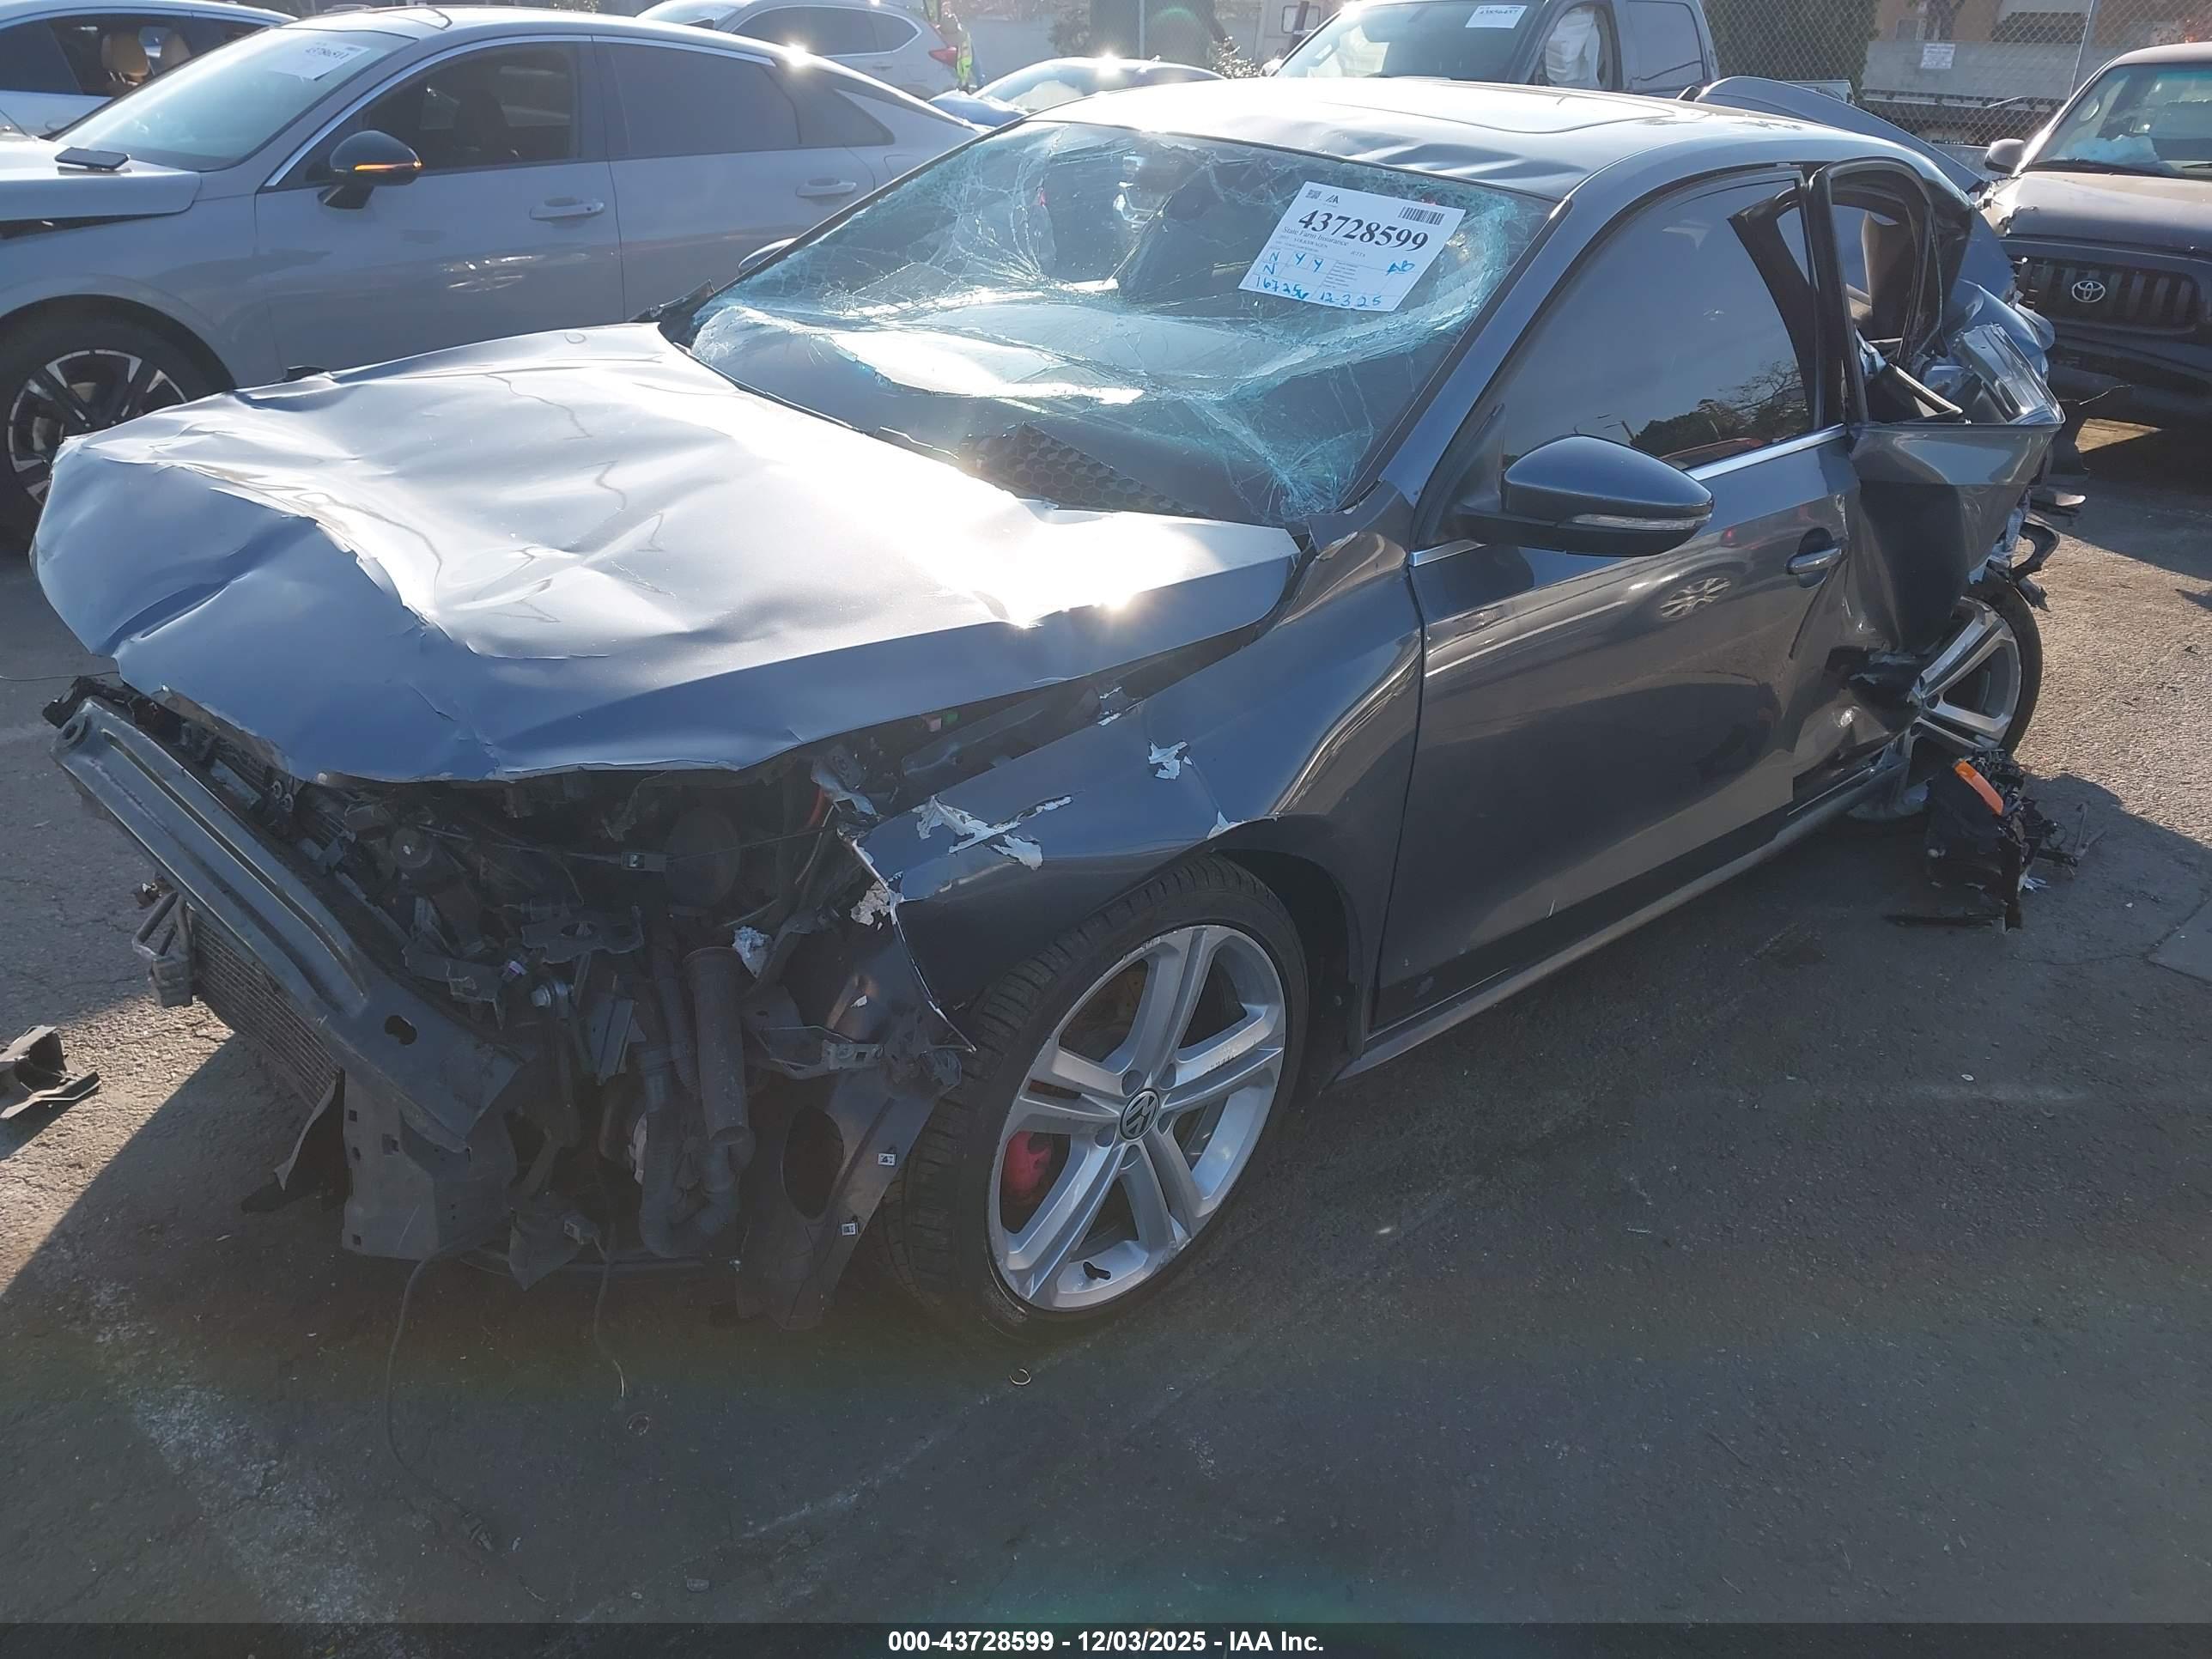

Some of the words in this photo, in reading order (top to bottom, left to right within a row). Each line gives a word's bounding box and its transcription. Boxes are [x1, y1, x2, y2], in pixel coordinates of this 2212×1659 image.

[1284, 226, 1299, 236] State
[1299, 230, 1317, 240] Farm
[1316, 234, 1349, 246] Insurance
[1298, 209, 1429, 252] 43728599
